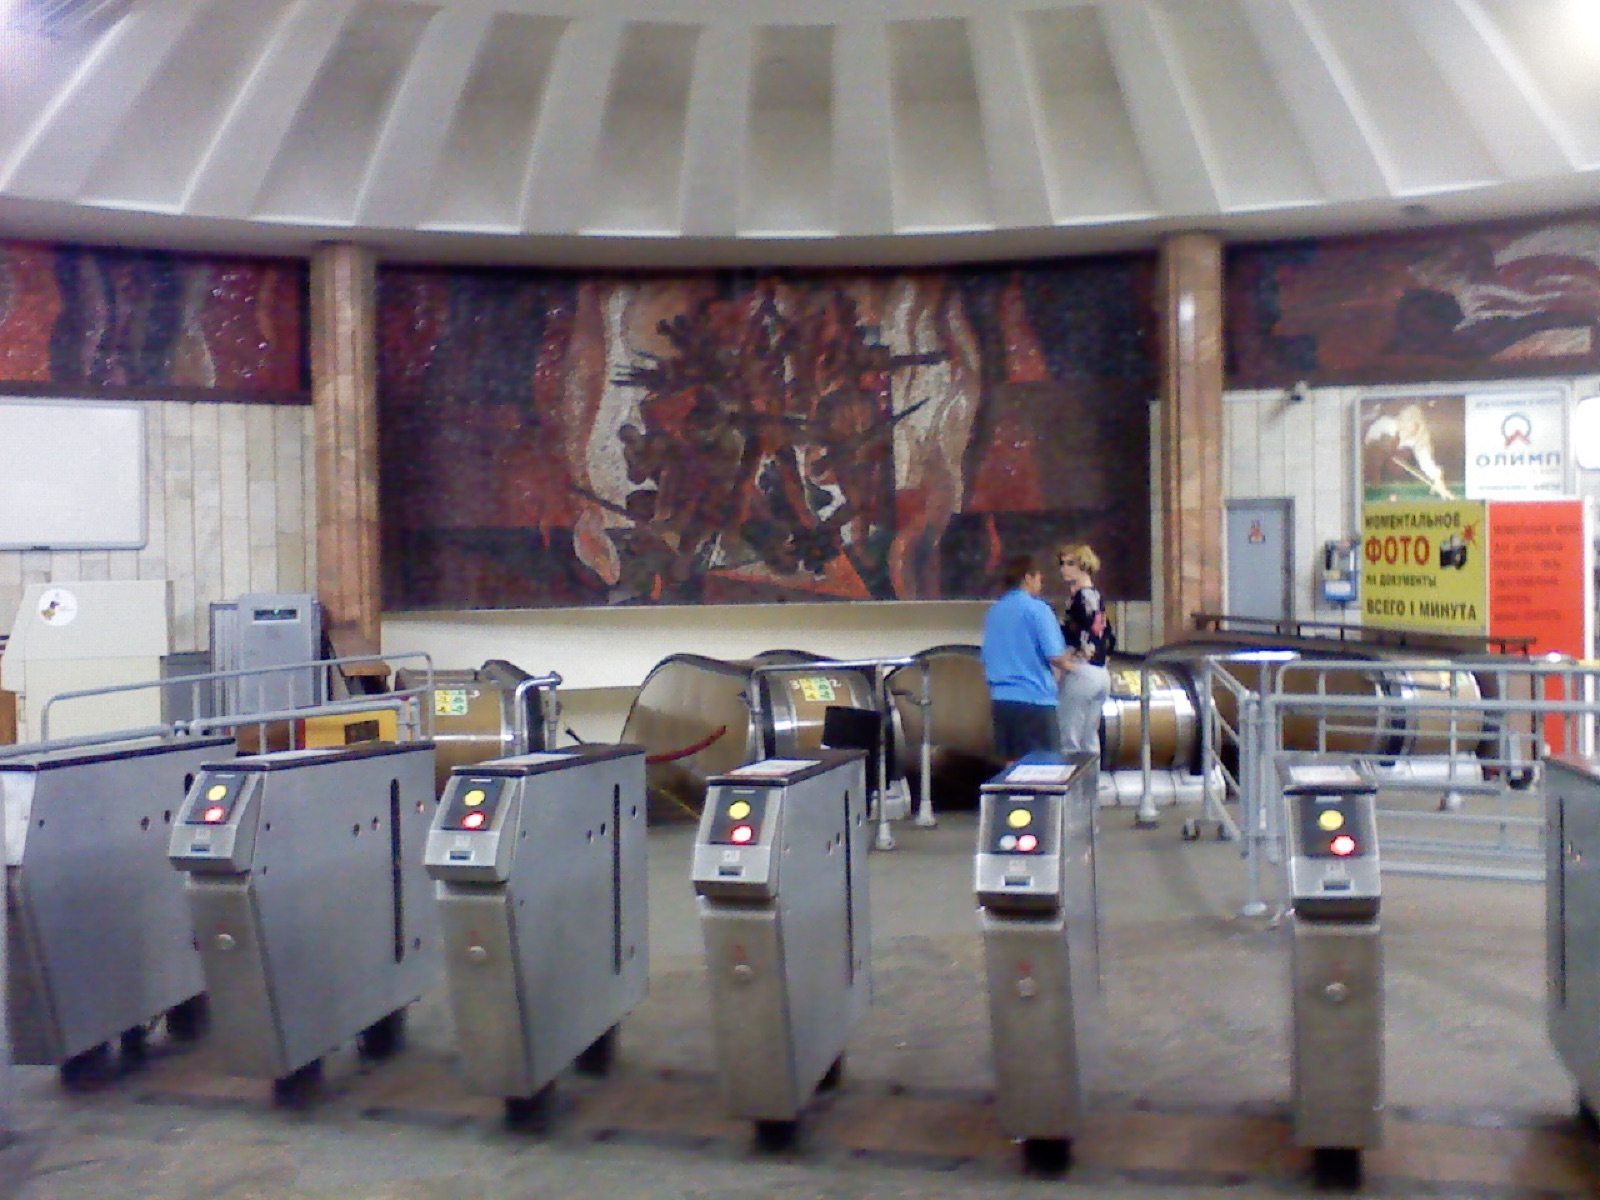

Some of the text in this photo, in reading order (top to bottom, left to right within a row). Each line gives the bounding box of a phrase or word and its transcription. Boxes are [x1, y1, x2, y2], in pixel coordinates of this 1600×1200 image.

[1475, 452, 1561, 468] ОЛИМП
[1364, 535, 1430, 566] ФОТО
[1366, 598, 1406, 616] ВСЕГО
[1419, 601, 1477, 621] МИНУТА
